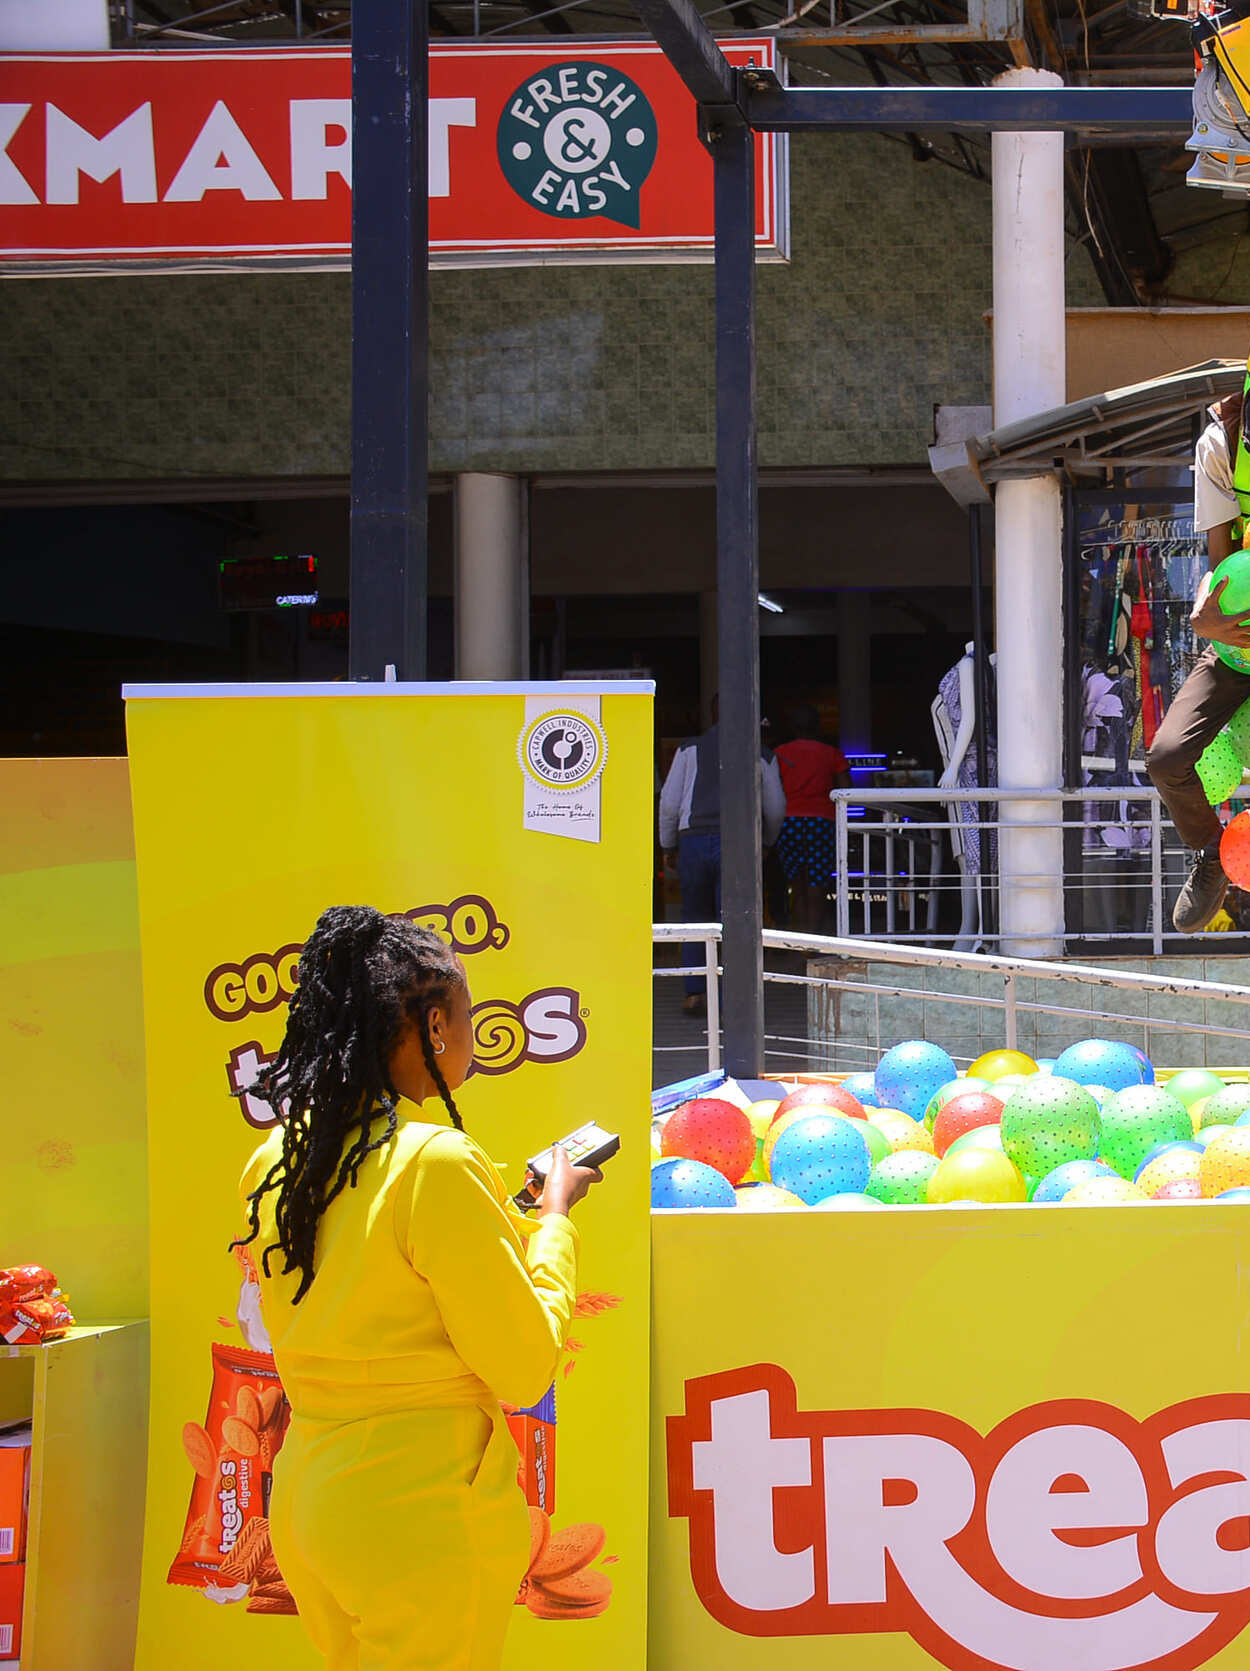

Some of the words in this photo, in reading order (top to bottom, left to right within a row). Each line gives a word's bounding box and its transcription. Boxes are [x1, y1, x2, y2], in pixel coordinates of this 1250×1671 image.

[510, 67, 636, 128] FRESH
[531, 160, 631, 213] EASY
[532, 720, 557, 750] CAPWELL
[558, 719, 593, 750] INDUSTRIES
[534, 758, 551, 776] MARK
[552, 771, 562, 780] OF
[564, 758, 590, 780] QUALITY
[212, 951, 300, 1013] GOO
[237, 1458, 250, 1509] digestive
